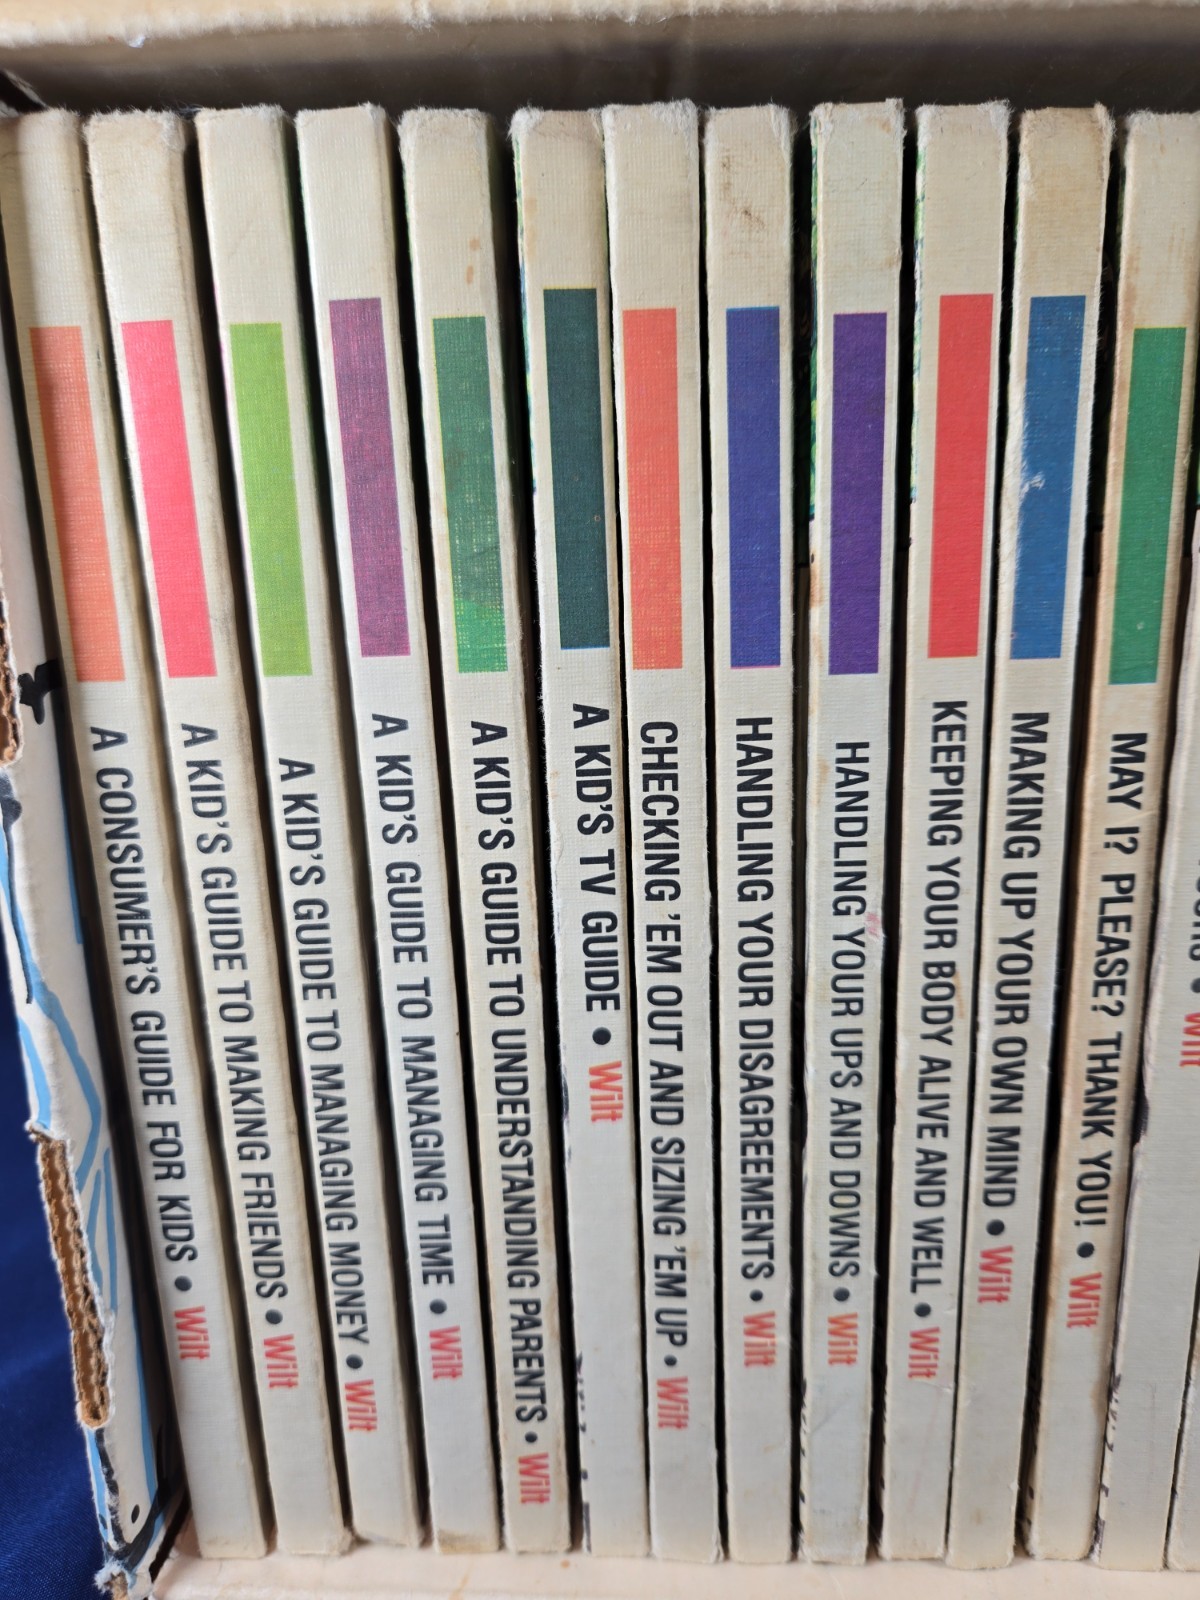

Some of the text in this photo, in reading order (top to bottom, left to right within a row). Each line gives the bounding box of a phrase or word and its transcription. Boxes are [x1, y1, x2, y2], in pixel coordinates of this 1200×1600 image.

[89, 726, 210, 1361] A CONSUMER'S GUIDE FOR KIDS Wilt
[181, 723, 299, 1390] A KID'S GUIDE TO MAKING FRIENDS Wilt
[278, 758, 378, 1433] A KID'S GUIDE TO MANAGING MONEY Wilt
[371, 713, 463, 1380] A KID'S GUIDE TO MANAGING TIME Wilt
[470, 720, 552, 1505] A KID'S GUIDE TO UNDERSTANDING PARENTS Wilt
[572, 703, 624, 1124] A KID'S TV GUIDE Wilt
[640, 721, 690, 1430] CHECKING 'EM OUT AND SIZING 'EM UP Wilt
[735, 717, 777, 1368] HANDLING YOUR DISAGREEMENTS Wilt
[827, 741, 870, 1366] HANDLING YOUR UPS AND DOWNS Wilt
[907, 700, 968, 1380] KEEPING YOUR BODY ALIVE AND WELL Wilt
[976, 712, 1050, 1304] MAKING UP YOUR OWN MIND Wilt
[1066, 732, 1148, 1329] MAY I? PLEASE? THANK YOU! Wilt
